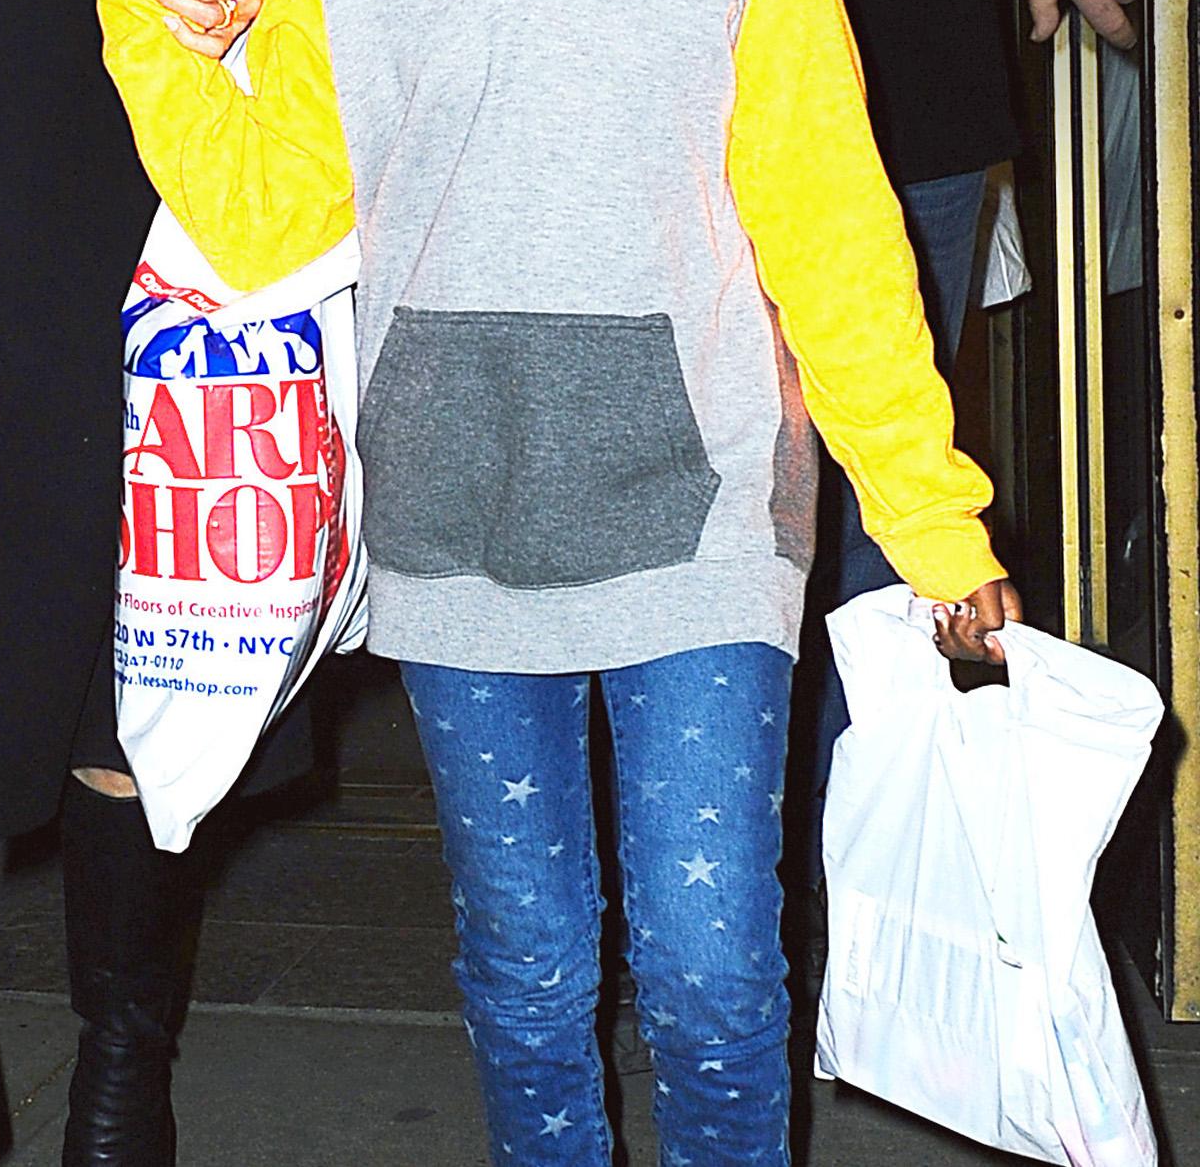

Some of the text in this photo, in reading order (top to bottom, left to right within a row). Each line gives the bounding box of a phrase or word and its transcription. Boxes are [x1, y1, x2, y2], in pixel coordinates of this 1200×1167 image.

[122, 379, 321, 480] ART
[125, 592, 163, 615] Floors
[168, 600, 184, 616] of
[189, 602, 263, 619] Creative
[134, 627, 156, 648] W
[164, 628, 215, 652] 57th
[237, 636, 296, 658] NYC
